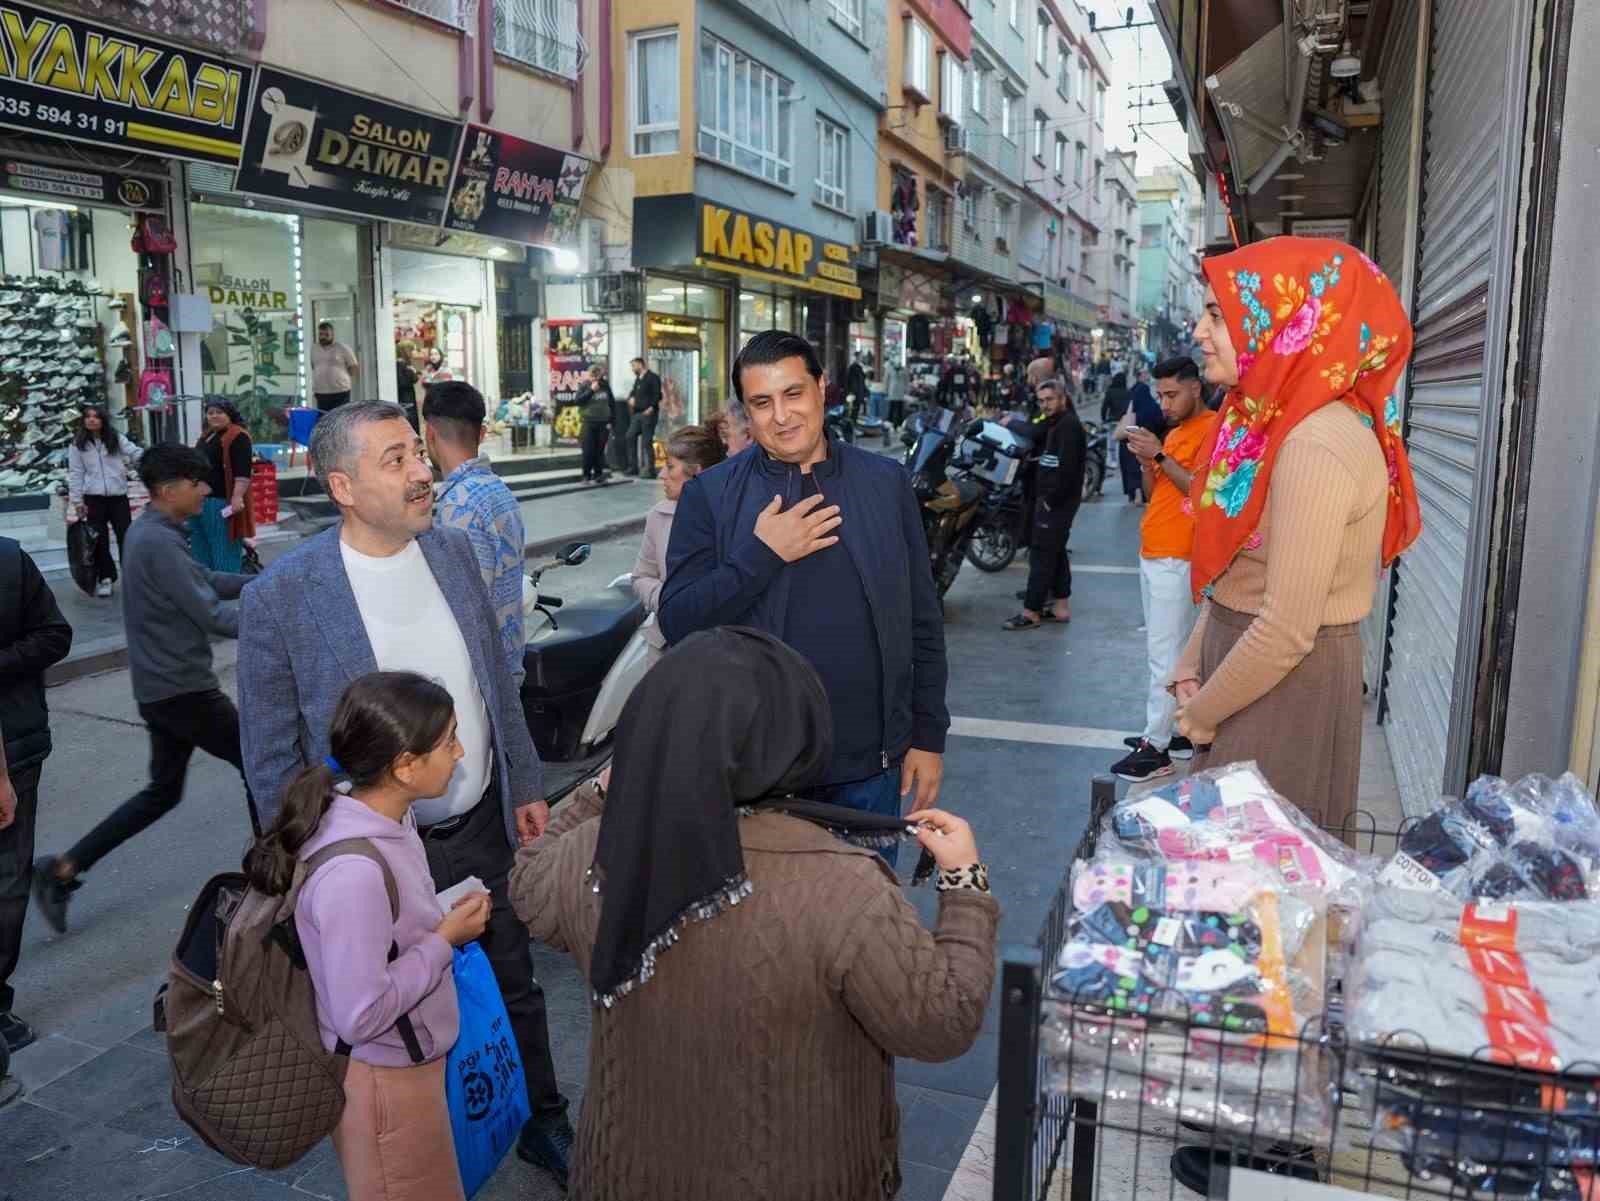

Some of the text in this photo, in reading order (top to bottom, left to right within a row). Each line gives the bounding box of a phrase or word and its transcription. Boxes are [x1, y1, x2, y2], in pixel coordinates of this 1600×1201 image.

[0, 7, 241, 129] YAKKABI
[36, 103, 72, 126] 594
[77, 112, 98, 131] 31
[104, 118, 125, 136] 91
[351, 113, 431, 153] SALON
[317, 127, 450, 189] DAMAR
[703, 202, 813, 275] KASAP
[208, 286, 287, 309] DAMAR
[223, 275, 270, 293] SALON
